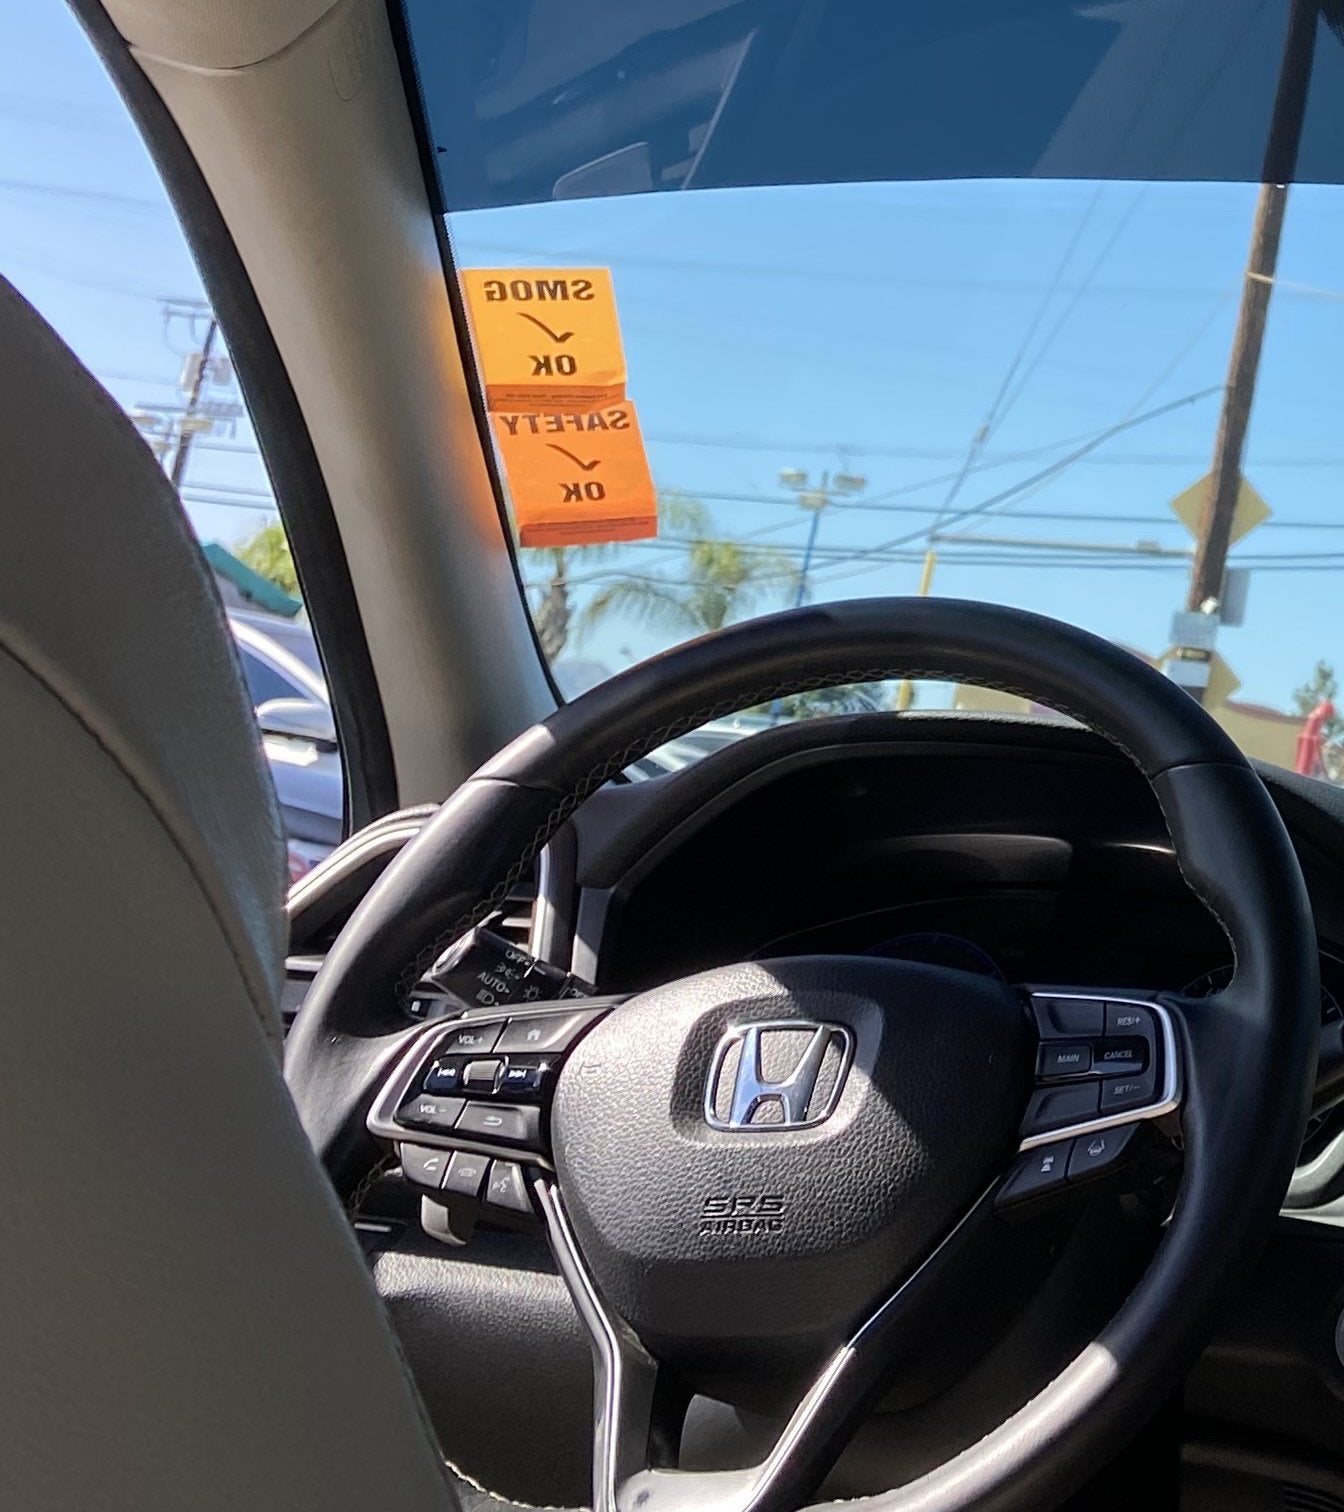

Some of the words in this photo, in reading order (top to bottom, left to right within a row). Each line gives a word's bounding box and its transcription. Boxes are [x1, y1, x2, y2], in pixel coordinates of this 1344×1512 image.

[505, 950, 526, 965] OFF
[477, 971, 506, 992] AUTO
[1057, 1054, 1080, 1063] MAIN
[1104, 1049, 1133, 1060] CANCEL
[701, 1195, 784, 1216] SRS
[698, 1218, 785, 1236] AIRBAG
